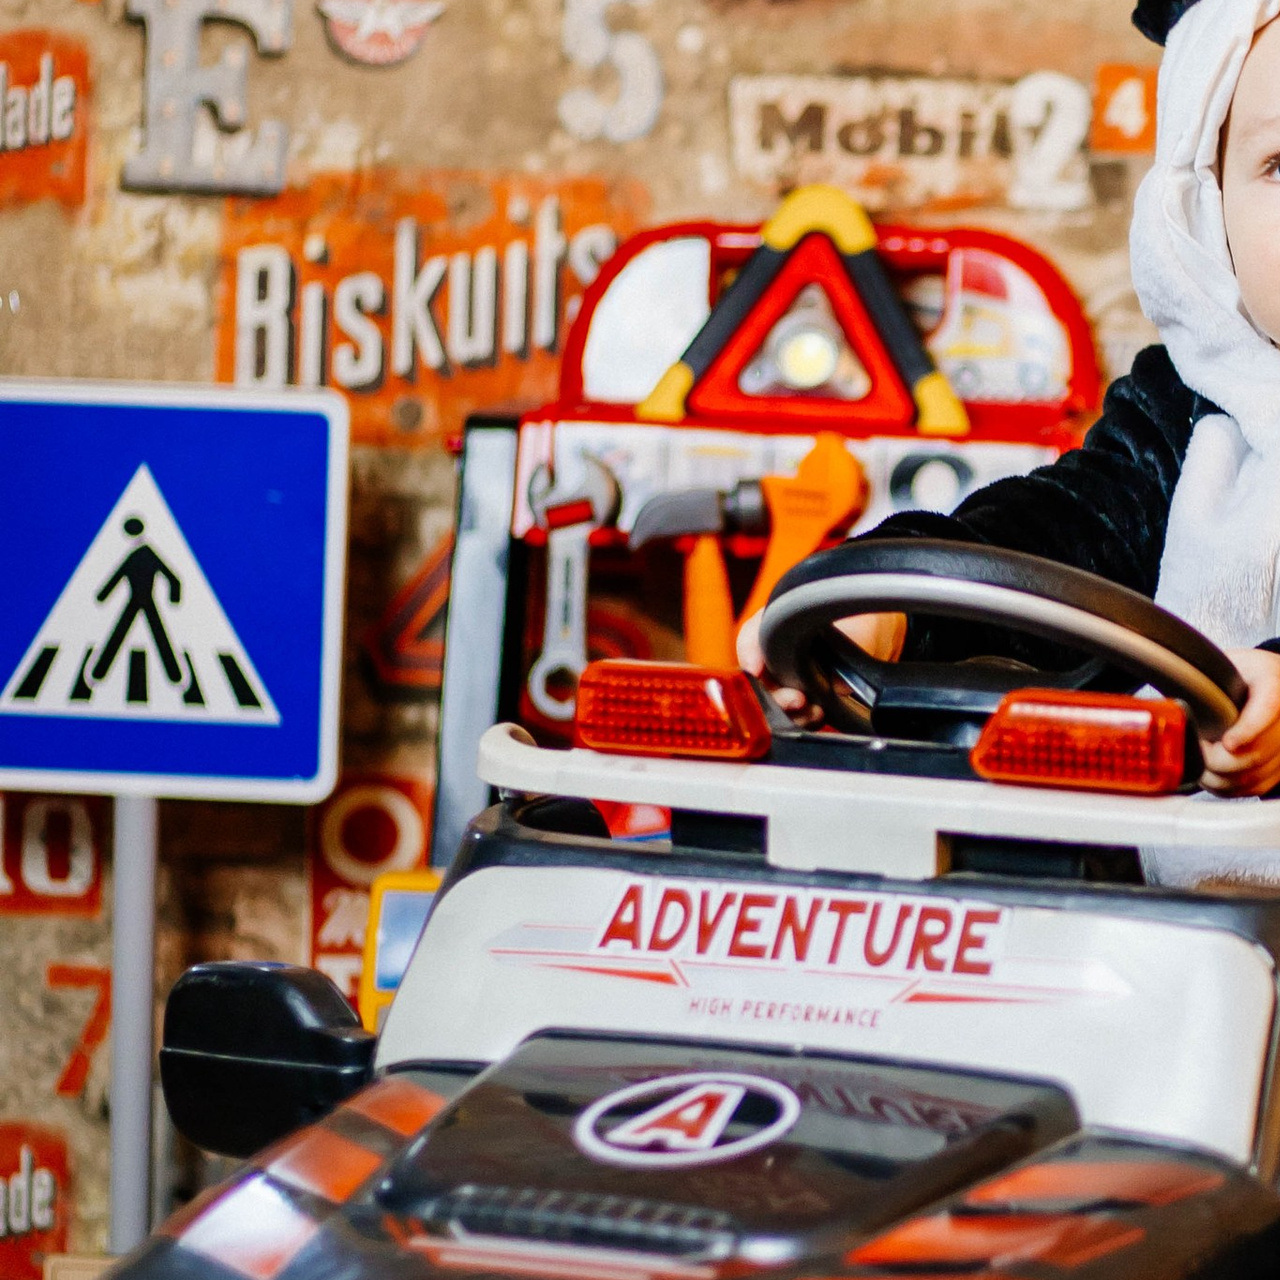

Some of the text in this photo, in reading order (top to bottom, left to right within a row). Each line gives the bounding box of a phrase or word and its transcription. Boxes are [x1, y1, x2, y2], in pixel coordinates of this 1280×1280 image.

[600, 884, 1001, 976] ADVENTURE
[689, 997, 882, 1029] HIGH PERFORMANCE
[612, 1084, 740, 1152] A
